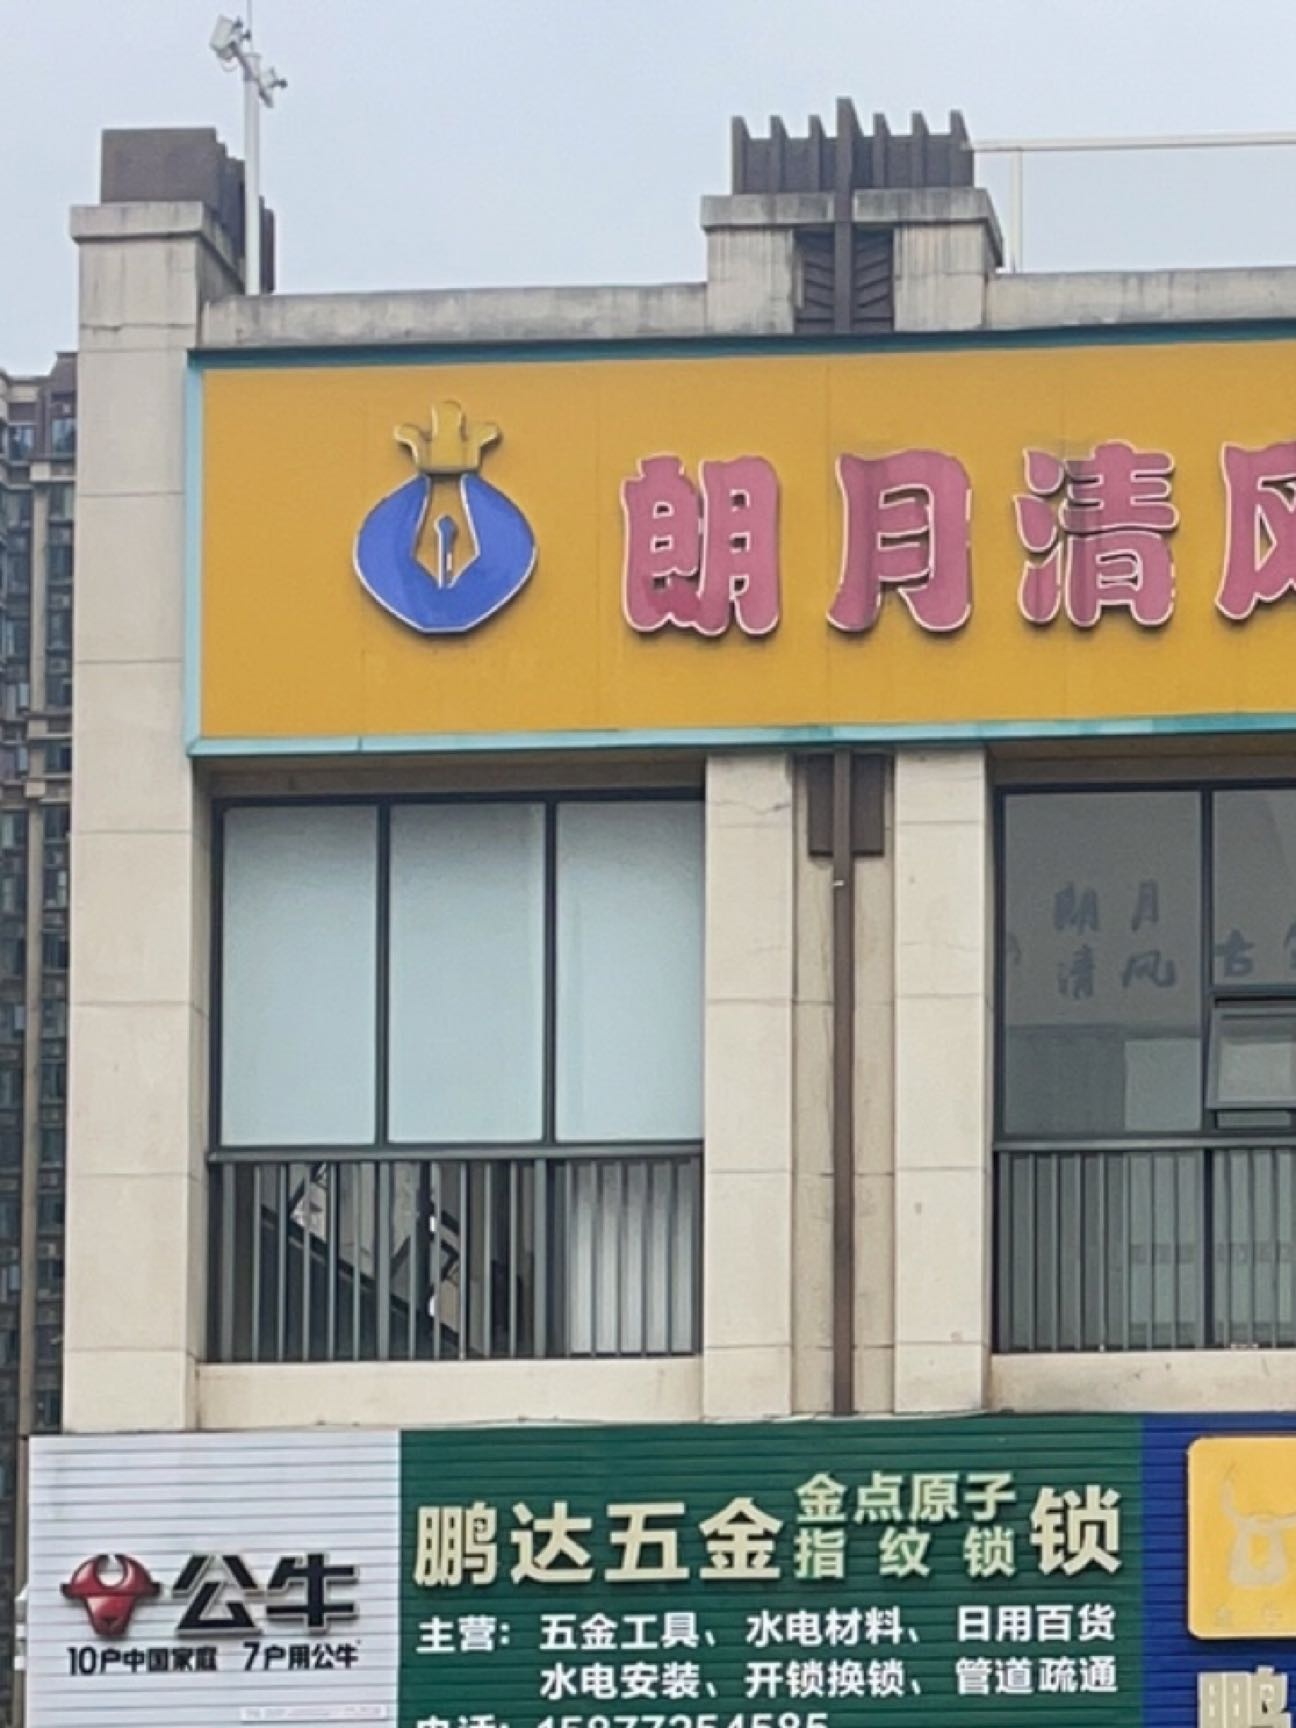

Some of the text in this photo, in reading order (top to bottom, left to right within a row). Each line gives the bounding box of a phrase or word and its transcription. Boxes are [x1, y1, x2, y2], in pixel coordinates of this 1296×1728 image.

[795, 1471, 1017, 1525] 金点原子
[1030, 1484, 1122, 1576] 锁
[414, 1497, 783, 1587] 鹏达五金
[794, 1525, 1016, 1579] 指纹锁
[172, 1553, 360, 1640] 公牛
[66, 1641, 359, 1676] 10户中国家庭 7户用公牛
